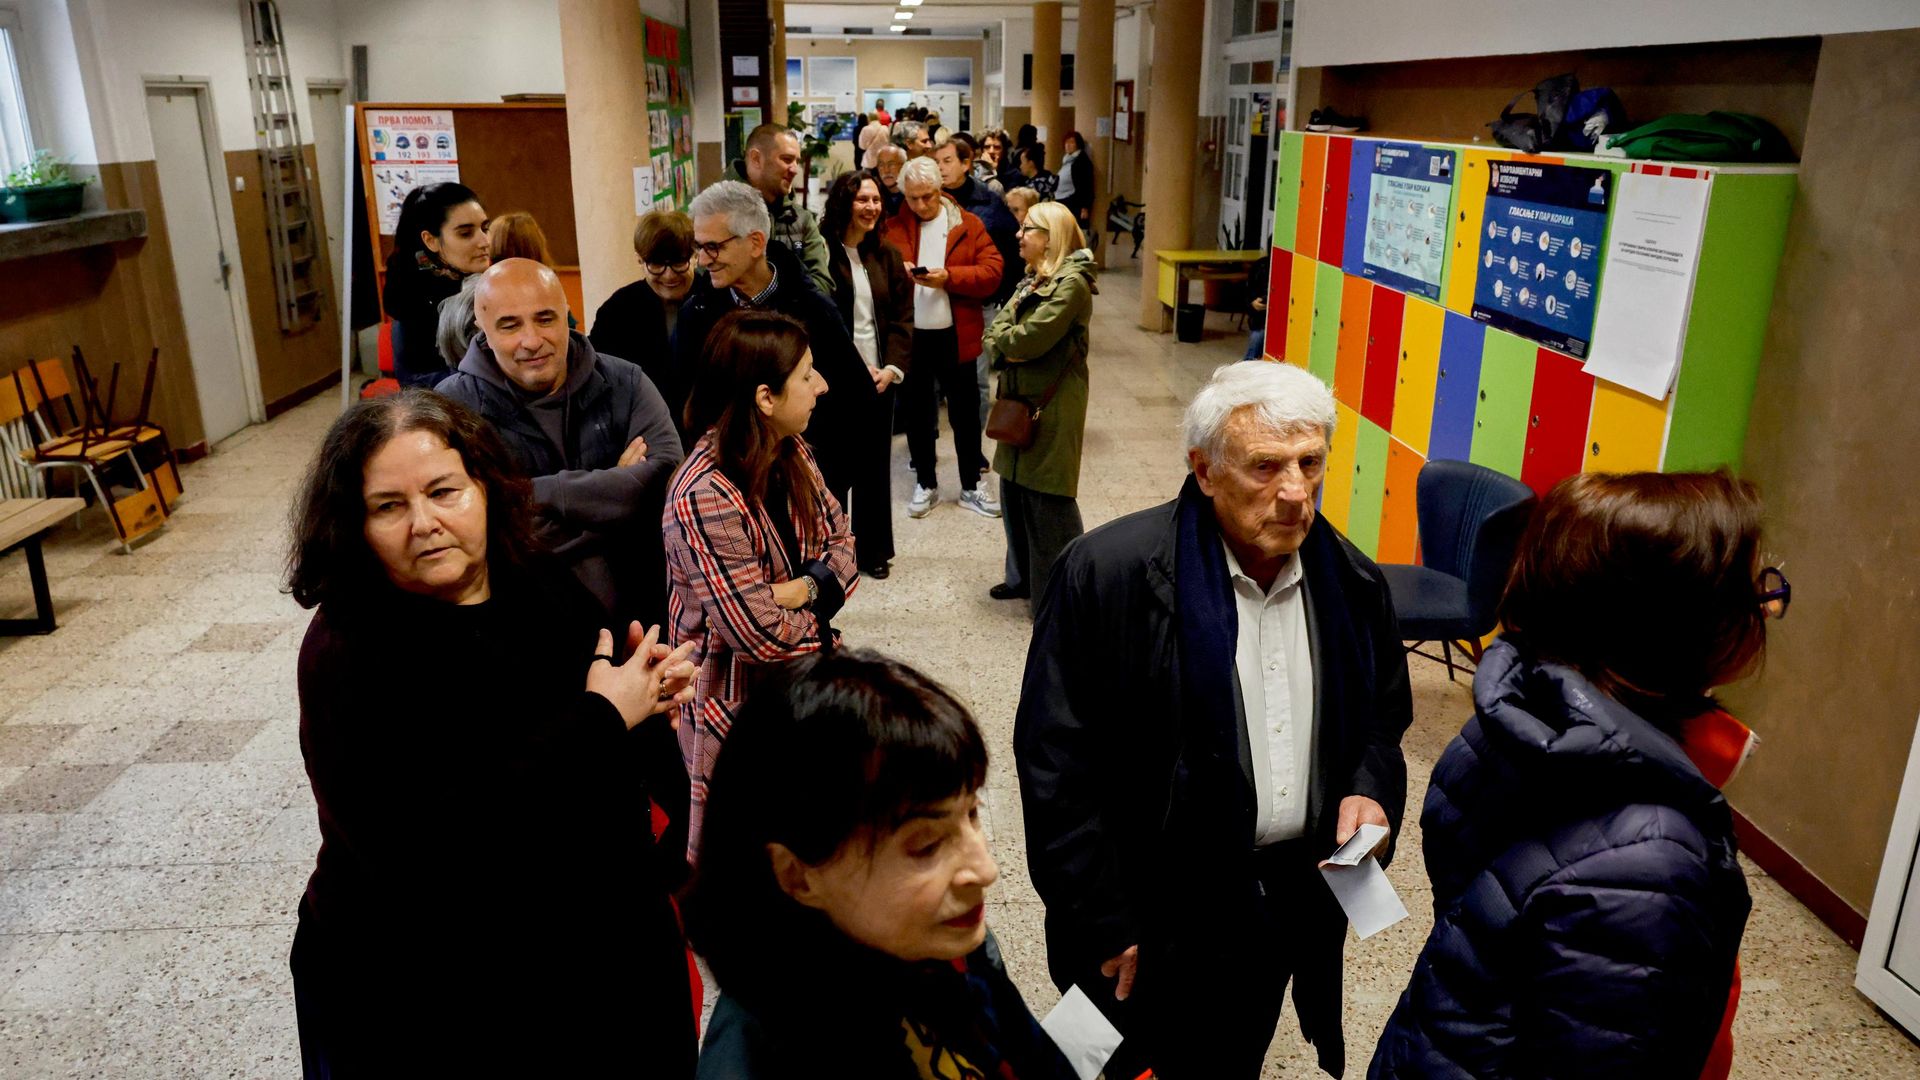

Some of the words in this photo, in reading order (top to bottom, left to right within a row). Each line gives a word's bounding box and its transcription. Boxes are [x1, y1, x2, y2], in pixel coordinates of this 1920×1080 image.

[378, 116, 401, 125] ПРВА
[402, 116, 433, 125] ПОМОЋ
[398, 151, 412, 159] 192
[417, 151, 430, 159] 193
[438, 151, 452, 159] 194
[1508, 206, 1535, 219] ГЛАСАЊЕ
[1539, 211, 1551, 222] ПАР
[1550, 213, 1574, 226] КОРАКА
